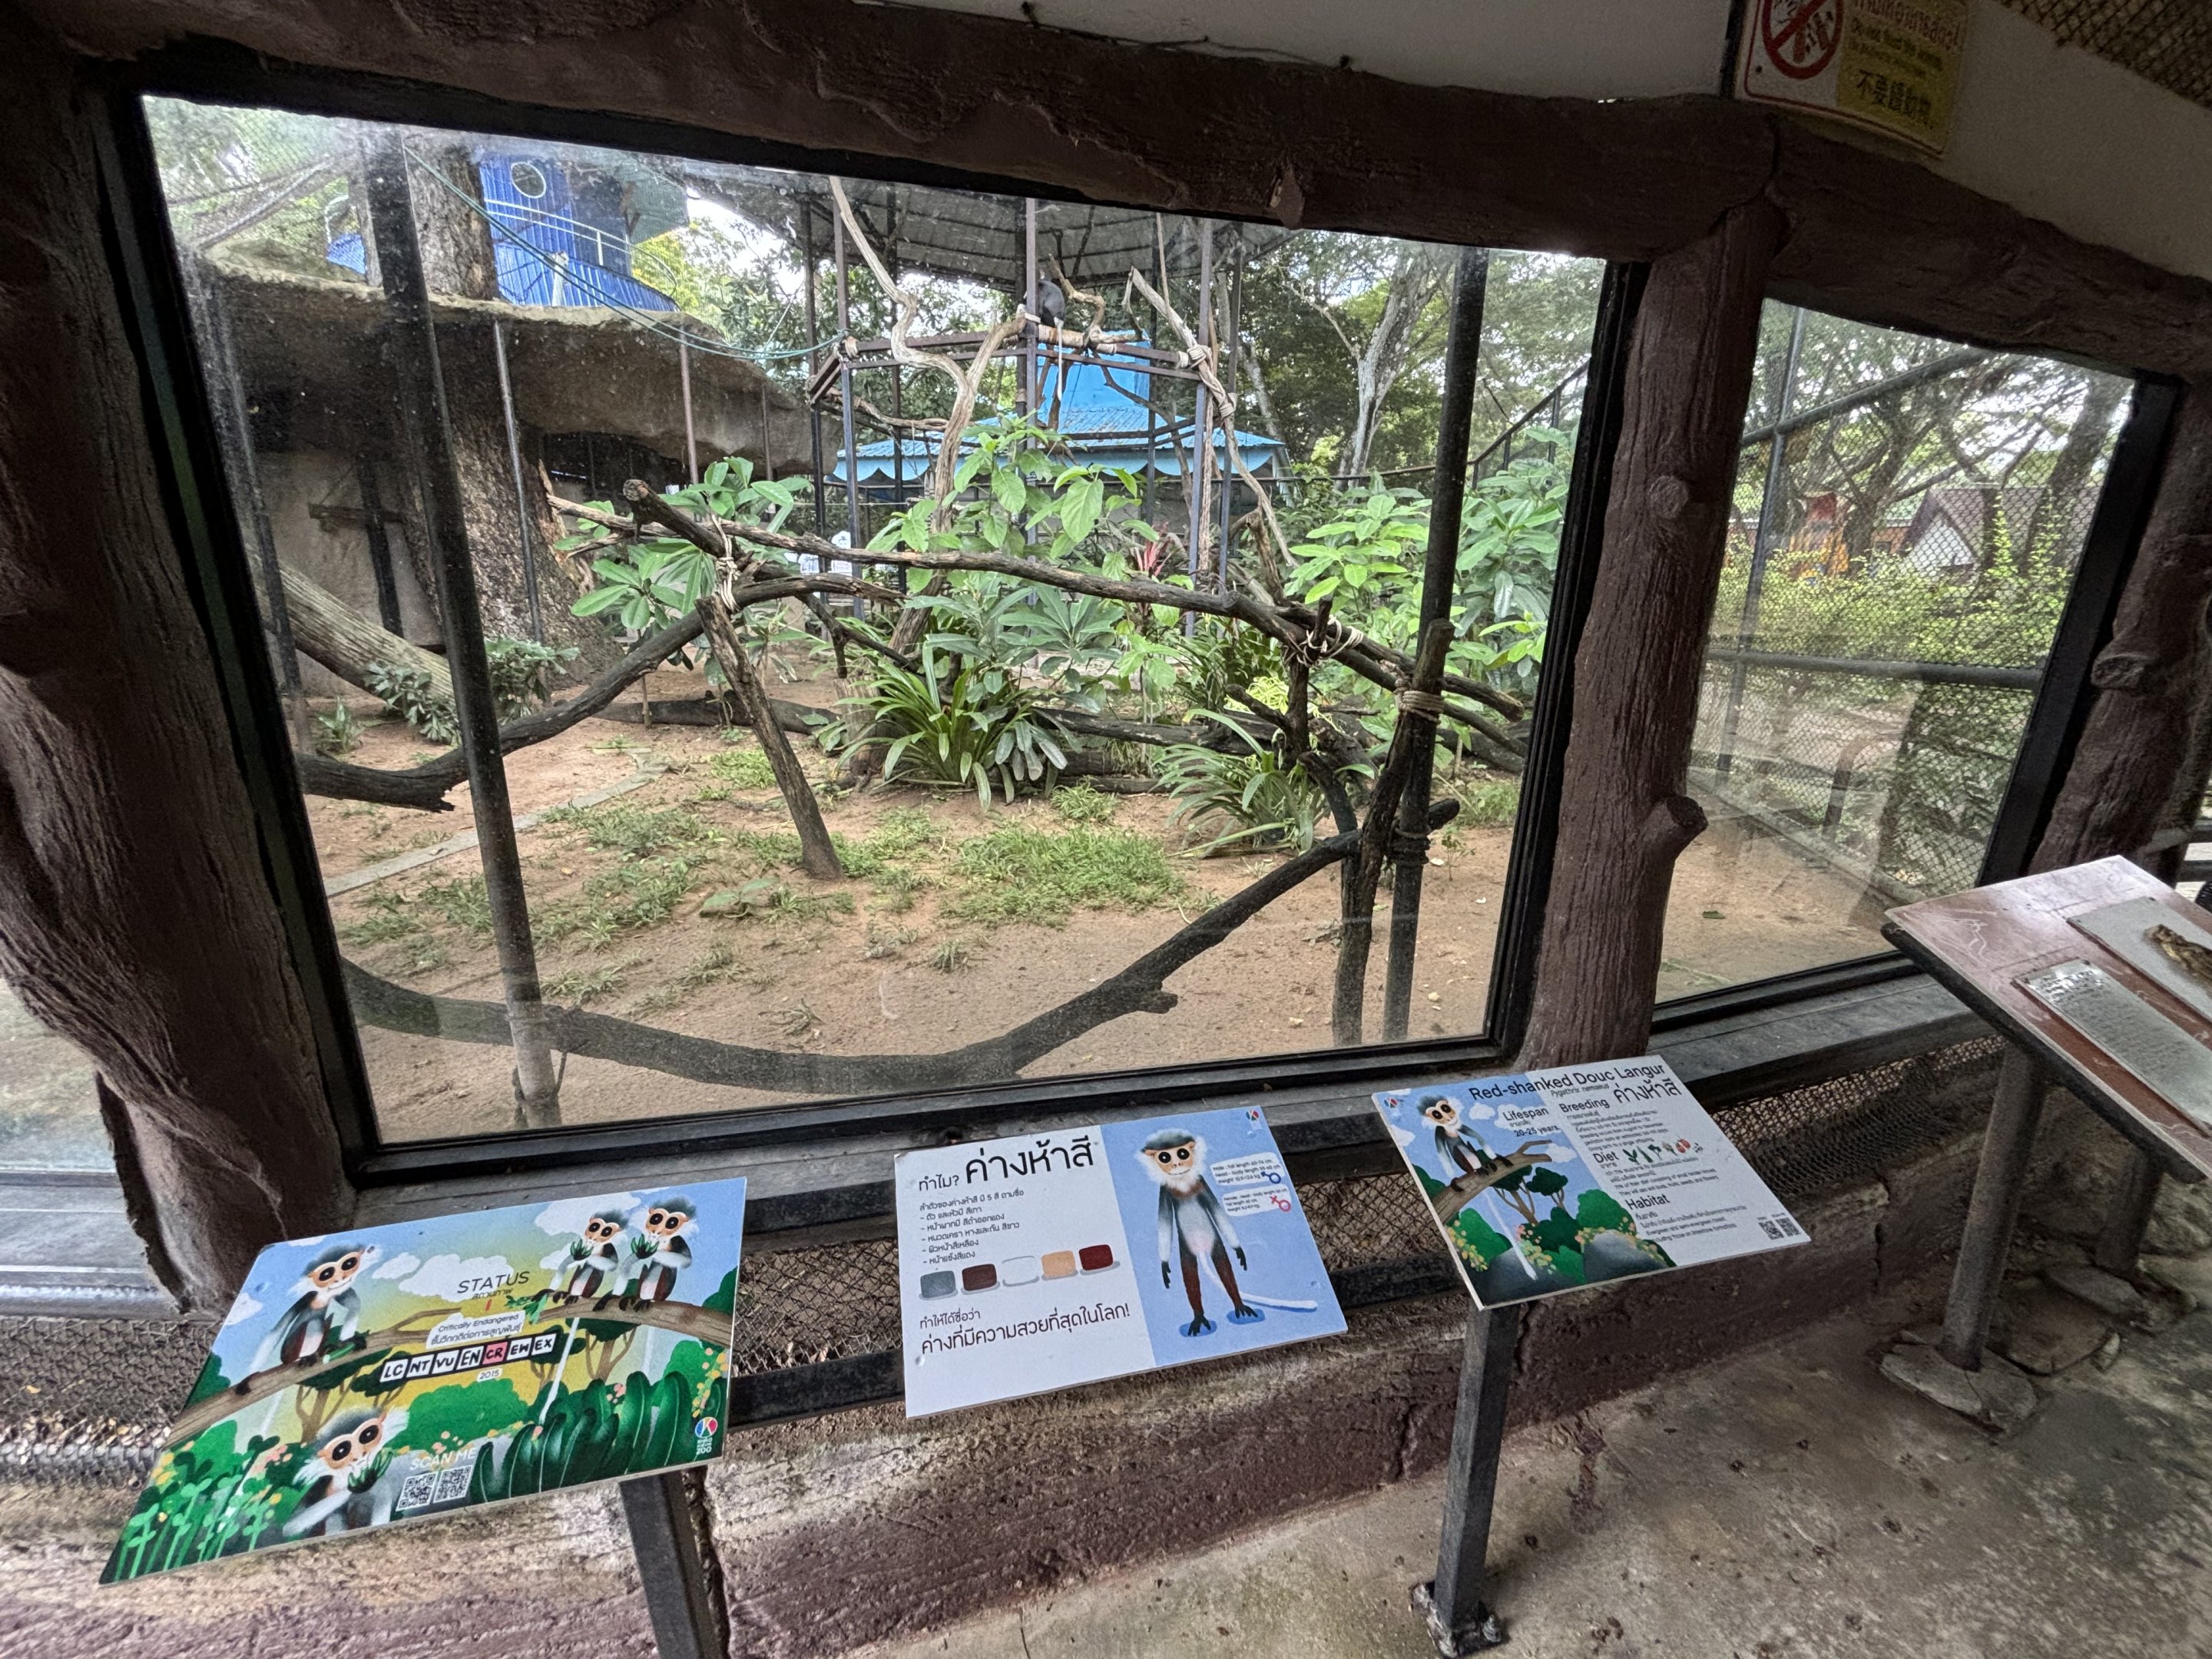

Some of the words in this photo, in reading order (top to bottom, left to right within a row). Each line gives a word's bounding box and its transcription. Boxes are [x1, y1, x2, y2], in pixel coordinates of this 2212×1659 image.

[1469, 1074, 1575, 1101] Red-shanked
[1572, 1070, 1615, 1084] Douc
[1613, 1063, 1666, 1081] Langur
[1614, 1078, 1682, 1104] ค่างห้าสี
[1502, 1108, 1550, 1121] Lifespan
[1559, 1098, 1610, 1113] Breeding
[1514, 1127, 1538, 1137] 20-25
[919, 1174, 959, 1191] ทำไม?
[965, 1134, 1094, 1184] ค่างห้าสี
[1593, 1151, 1620, 1164] Diet
[1626, 1194, 1671, 1210] Habitat
[457, 1271, 530, 1294] STATUS
[438, 1320, 472, 1333] Critically
[473, 1313, 520, 1328] Endangered
[920, 1307, 981, 1330] ทำให้ได้ชื่อว่า
[922, 1303, 1131, 1354] ค่างที่มีความสวยที่สุดในโลก!
[385, 1363, 404, 1379] LC
[409, 1359, 431, 1375] NT
[436, 1356, 456, 1368] VU
[462, 1349, 482, 1366] EN
[485, 1346, 504, 1360] CR
[510, 1342, 530, 1356] EW
[534, 1336, 553, 1351] EX
[479, 1369, 500, 1379] 2015
[409, 1451, 456, 1471] SCAN
[455, 1447, 477, 1463] ME
